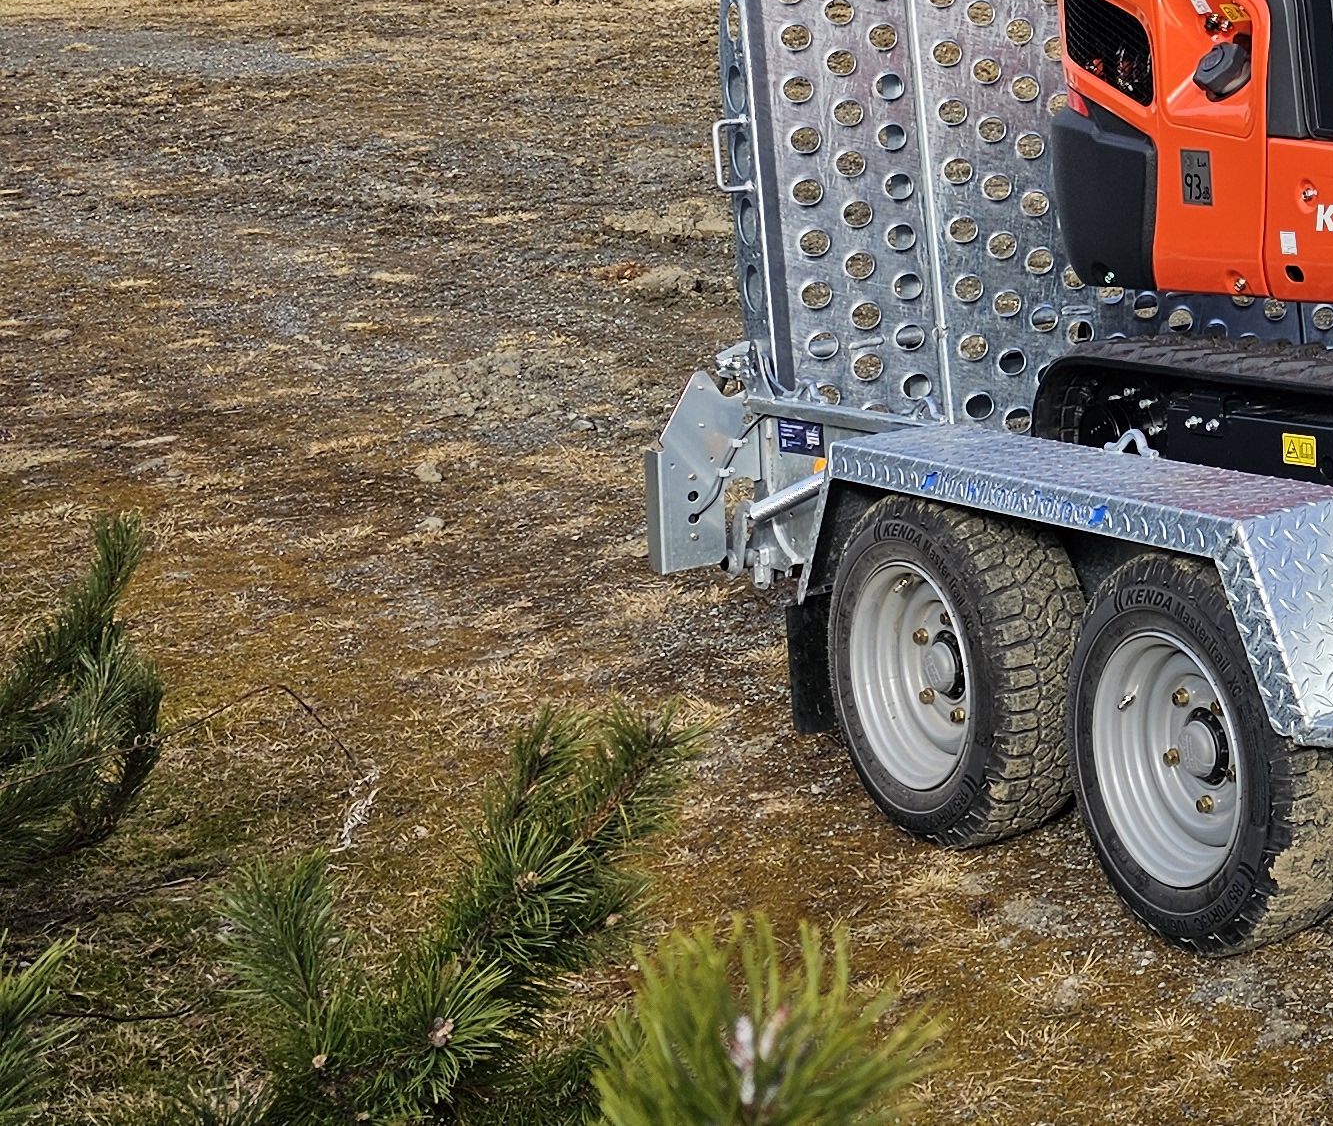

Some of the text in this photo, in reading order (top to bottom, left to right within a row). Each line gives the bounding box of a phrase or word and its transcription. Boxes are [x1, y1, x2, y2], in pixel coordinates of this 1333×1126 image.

[1184, 173, 1201, 200] 93
[882, 522, 923, 547] KENDA
[1125, 588, 1173, 612] KENDA
[1227, 675, 1243, 698] XC
[1194, 879, 1246, 931] 185/70R13C
